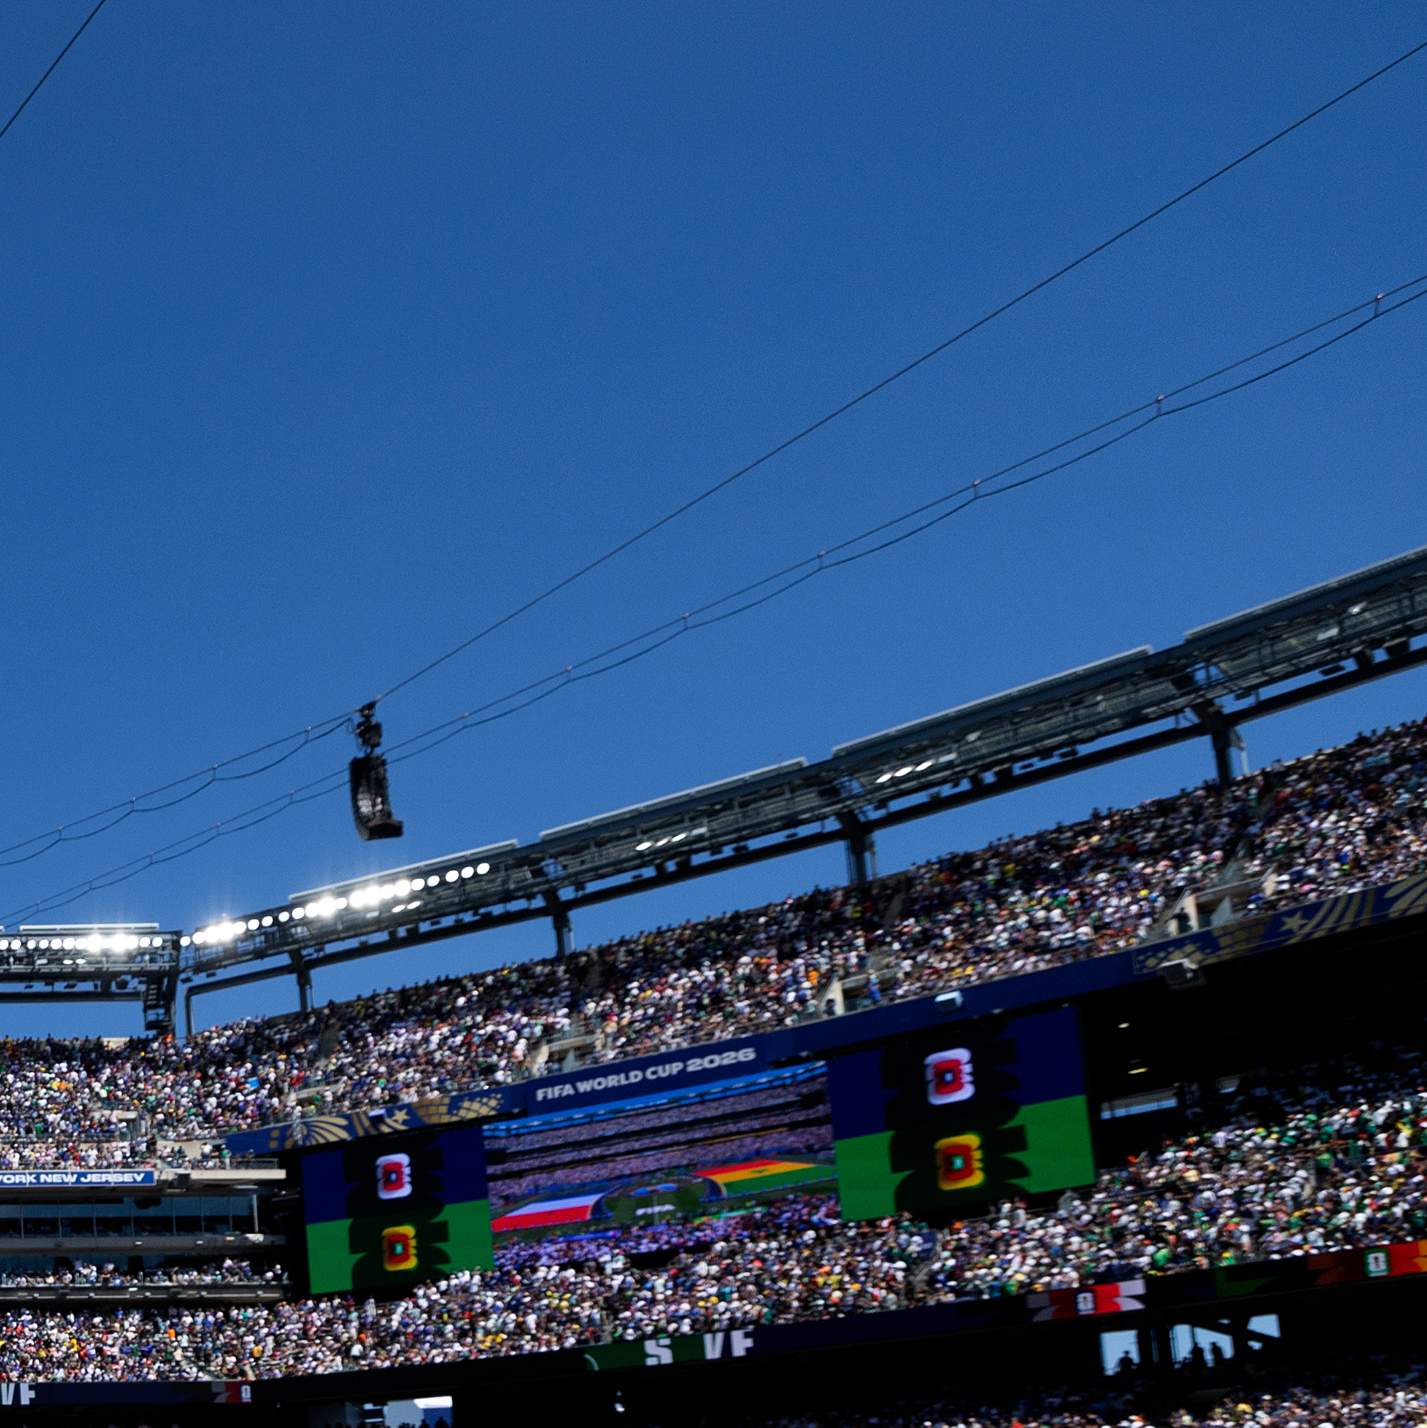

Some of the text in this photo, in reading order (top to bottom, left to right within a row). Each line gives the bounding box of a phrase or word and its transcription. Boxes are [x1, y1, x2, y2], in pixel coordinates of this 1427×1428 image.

[536, 1047, 757, 1102] FIFA WORLD CUP 2026
[40, 1173, 78, 1184] NEW
[80, 1172, 146, 1183] JERSEY
